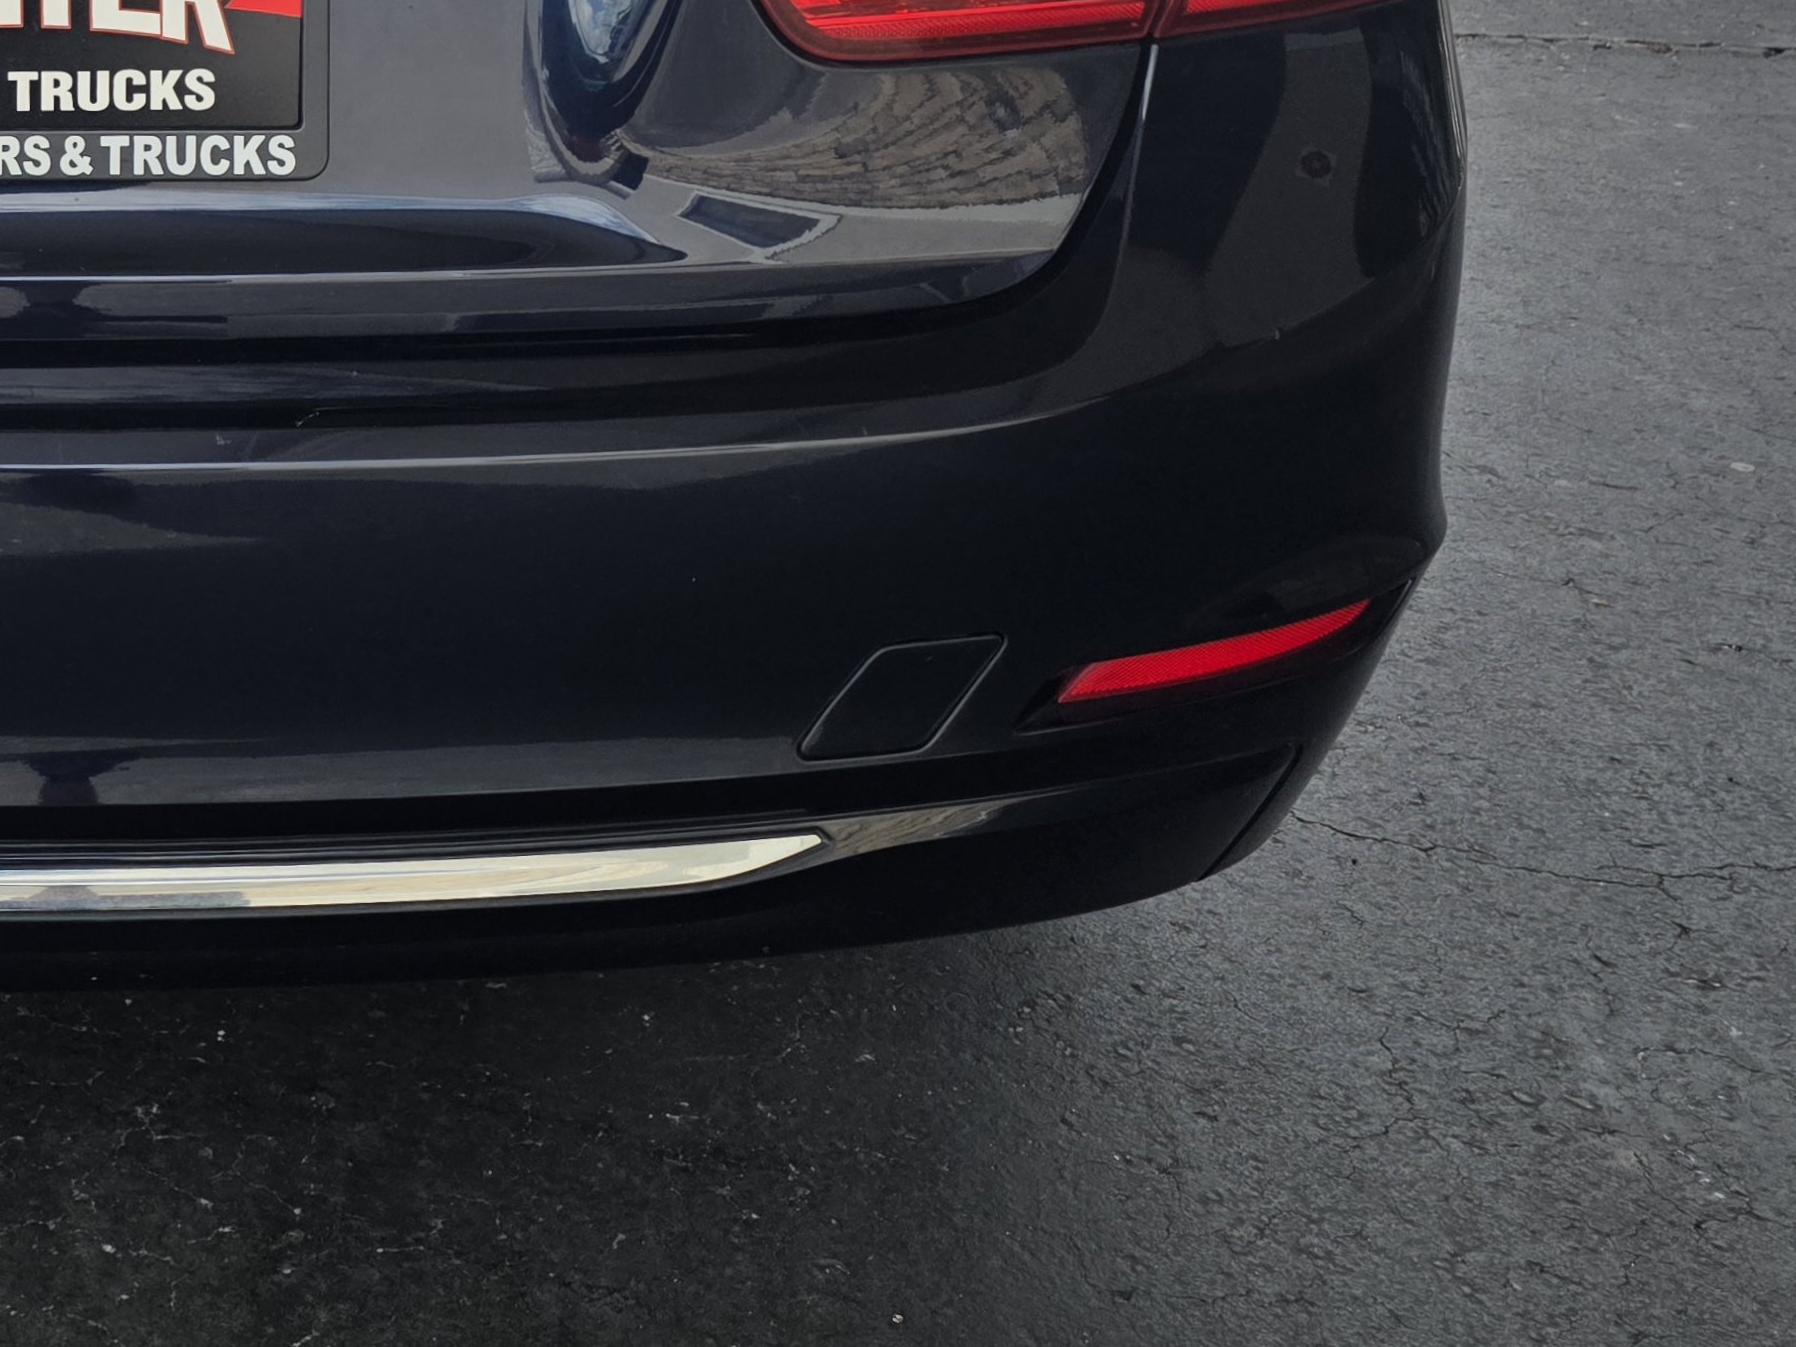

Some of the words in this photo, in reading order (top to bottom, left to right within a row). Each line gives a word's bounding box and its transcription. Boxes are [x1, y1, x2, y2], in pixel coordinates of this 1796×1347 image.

[8, 68, 217, 113] TRUCKS
[59, 135, 94, 177] &
[101, 134, 297, 177] TRUCKS
